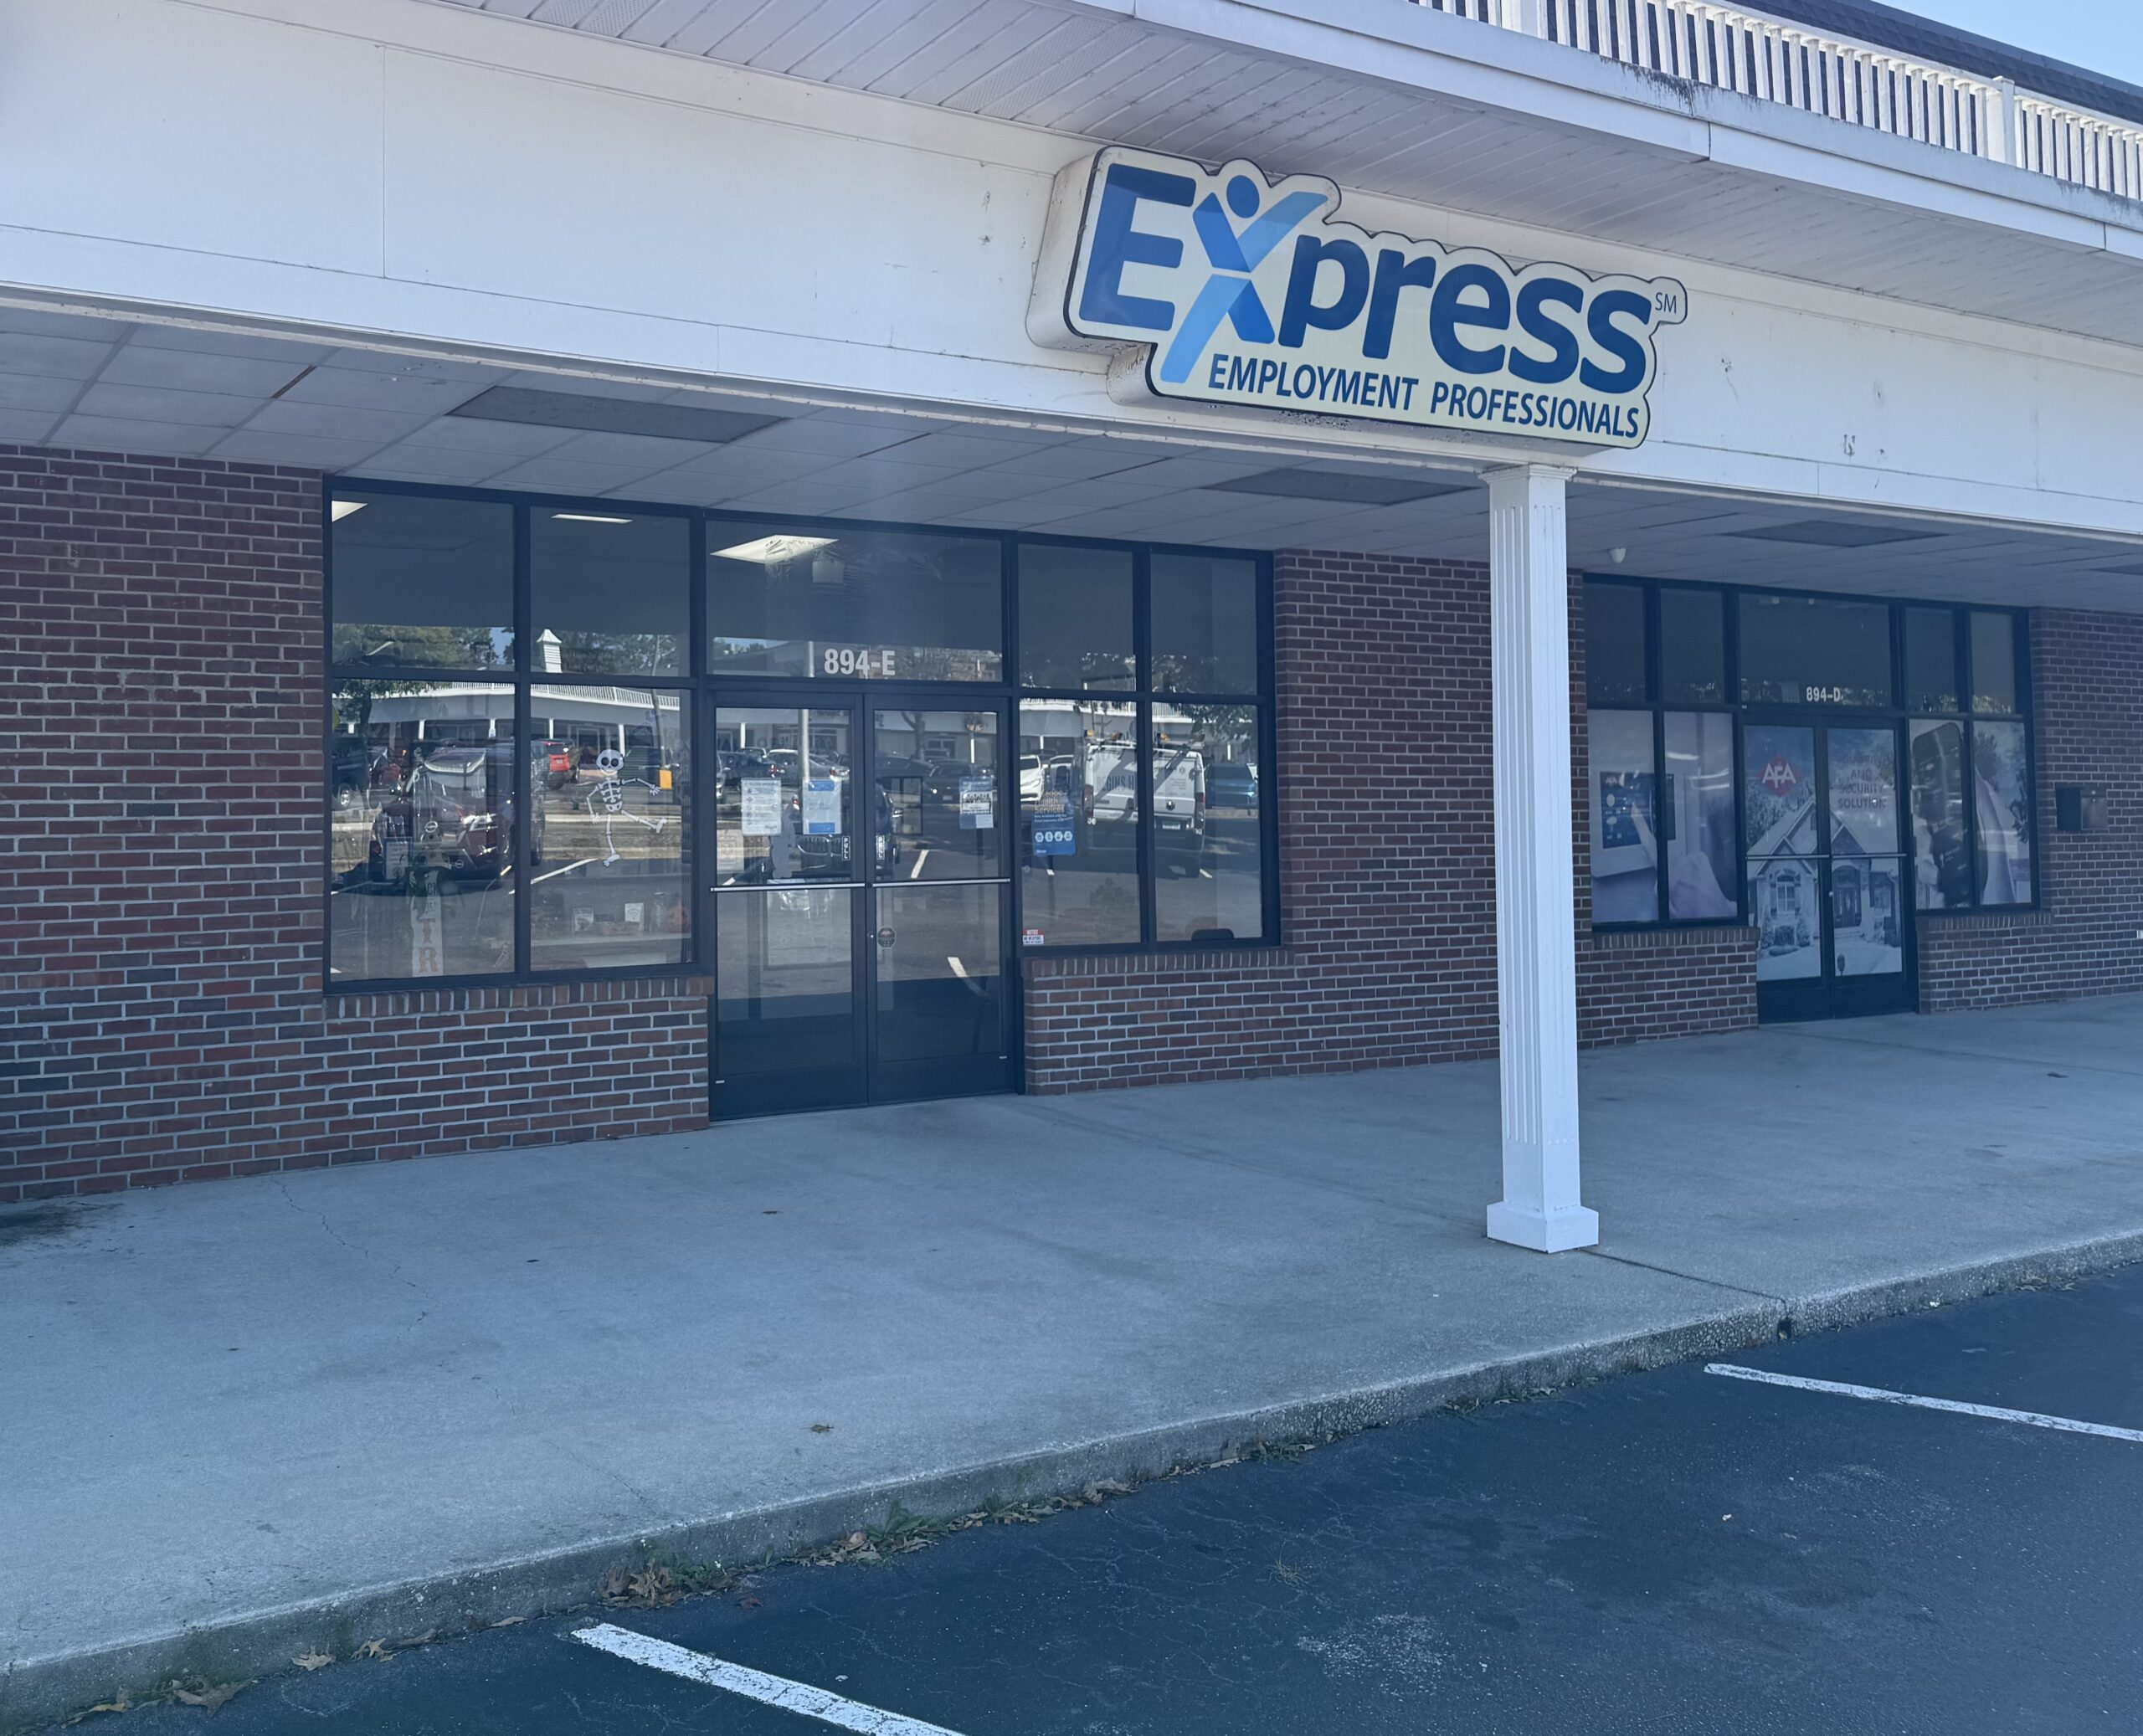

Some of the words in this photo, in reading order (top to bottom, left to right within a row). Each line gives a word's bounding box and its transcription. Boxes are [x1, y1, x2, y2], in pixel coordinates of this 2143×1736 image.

[1655, 292, 1677, 314] SM
[1208, 353, 1419, 410] EMPLOYMENT
[1431, 382, 1639, 439] PROFESSIONALS
[825, 649, 895, 675] 894-E
[1806, 687, 1841, 701] 894-D
[1762, 763, 1796, 788] AFA
